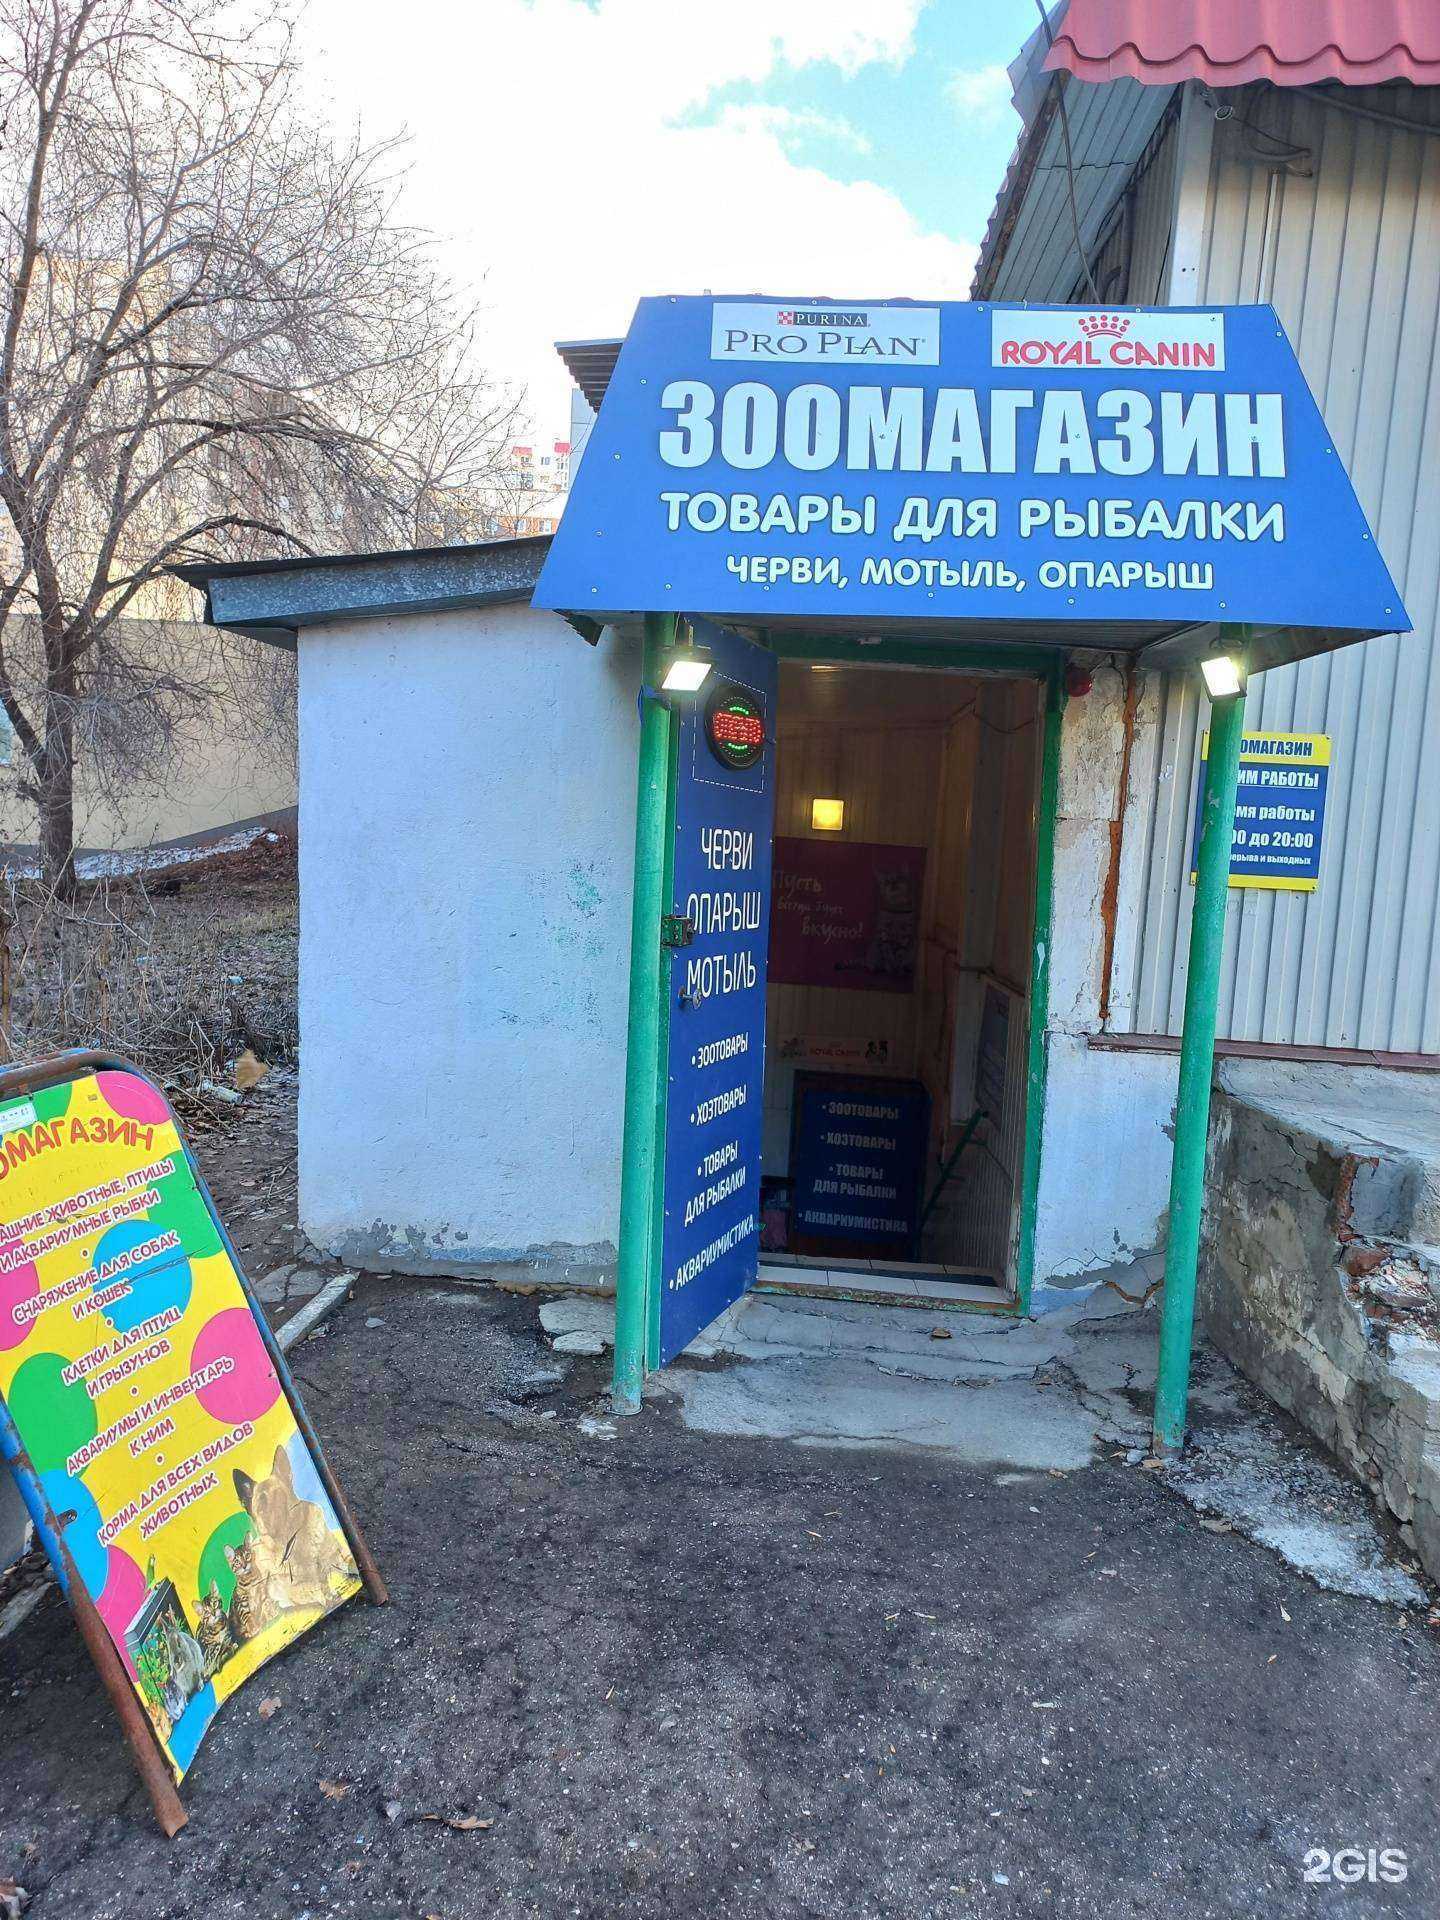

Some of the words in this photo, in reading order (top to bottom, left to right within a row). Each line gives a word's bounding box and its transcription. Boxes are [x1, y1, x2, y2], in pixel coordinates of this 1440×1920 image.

[795, 313, 865, 326] PURINA
[724, 329, 808, 355] PRO
[817, 331, 920, 356] PLAN
[1001, 340, 1102, 365] ROYAL
[1109, 340, 1216, 367] CANIN
[658, 380, 1286, 478] ЗООМАГАЗИН
[660, 491, 877, 536] ТОВАРЫ
[893, 496, 997, 543] ДЛЯ
[1019, 498, 1286, 542] РЫБАЛКИ
[725, 554, 850, 590] ЧЕРВИ,
[860, 557, 1026, 593] МОТЫЛЬ,
[1038, 560, 1214, 591] ОПАРЫШ
[1240, 739, 1313, 756] ОМАГАЗИН
[1260, 770, 1319, 787] РАБОТЫ
[1259, 805, 1315, 821] работы
[701, 828, 753, 870] ЧЕРВИ
[1248, 832, 1270, 847] до
[1272, 831, 1314, 848] 20:00
[1267, 855, 1312, 865] выходных
[686, 891, 761, 935] ОПАРЫШ
[687, 950, 756, 998] МОТЫЛЬ
[697, 1031, 749, 1070] ЗООТОВАРЫ
[696, 1084, 747, 1126] ХОЗТОВАРЫ
[828, 1101, 899, 1120] ЗООТОВАРЫ
[0, 1116, 154, 1180] МАГАЗИН
[703, 1140, 738, 1178] ТОВАРЫ
[827, 1132, 897, 1151] ХОЗТОВАРЫ
[813, 1179, 838, 1194] ДЛЯ
[840, 1182, 897, 1199] РЫБАЛКИ
[835, 1163, 884, 1180] ТОВАРЫ
[0, 1212, 45, 1243] АШНИЕ
[45, 1180, 127, 1222] ЖИВОТНЫЕ,
[127, 1160, 174, 1188] ПТИЦЫ
[684, 1194, 705, 1227] ДЛЯ
[706, 1165, 746, 1210] РЫБАЛКИ
[15, 1208, 111, 1264] АКВАРИУМНЫЕ
[112, 1190, 160, 1220] РЫБКИ
[804, 1210, 909, 1233] АКВАРИУМИСТИКА
[676, 1213, 754, 1290] АКВАРИУМИСТИКА
[13, 1269, 98, 1323] СНАРЯЖЕНИЕ
[102, 1254, 130, 1278] ДЛЯ
[131, 1232, 180, 1262] СОБАК
[73, 1304, 84, 1319] И
[85, 1281, 132, 1312] КОШЕК
[63, 1346, 110, 1383] КЛЕТКИ
[112, 1329, 142, 1355] ДЛЯ
[142, 1307, 181, 1337] ПТИЦ
[87, 1382, 98, 1397] И
[99, 1340, 170, 1390] ГРЫЗУНОВ
[67, 1411, 142, 1475] АКВАРИУМЫ
[142, 1404, 153, 1419] И
[154, 1356, 234, 1412] ИНВЕНТАРЬ
[129, 1441, 141, 1456] К
[141, 1419, 174, 1447] НИМ
[98, 1502, 139, 1545] КОРМА
[139, 1480, 167, 1510] ДЛЯ
[168, 1455, 202, 1487] ВСЕХ
[202, 1422, 253, 1462] ВИДОВ
[140, 1473, 218, 1539] ЖИВОТНЫХ
